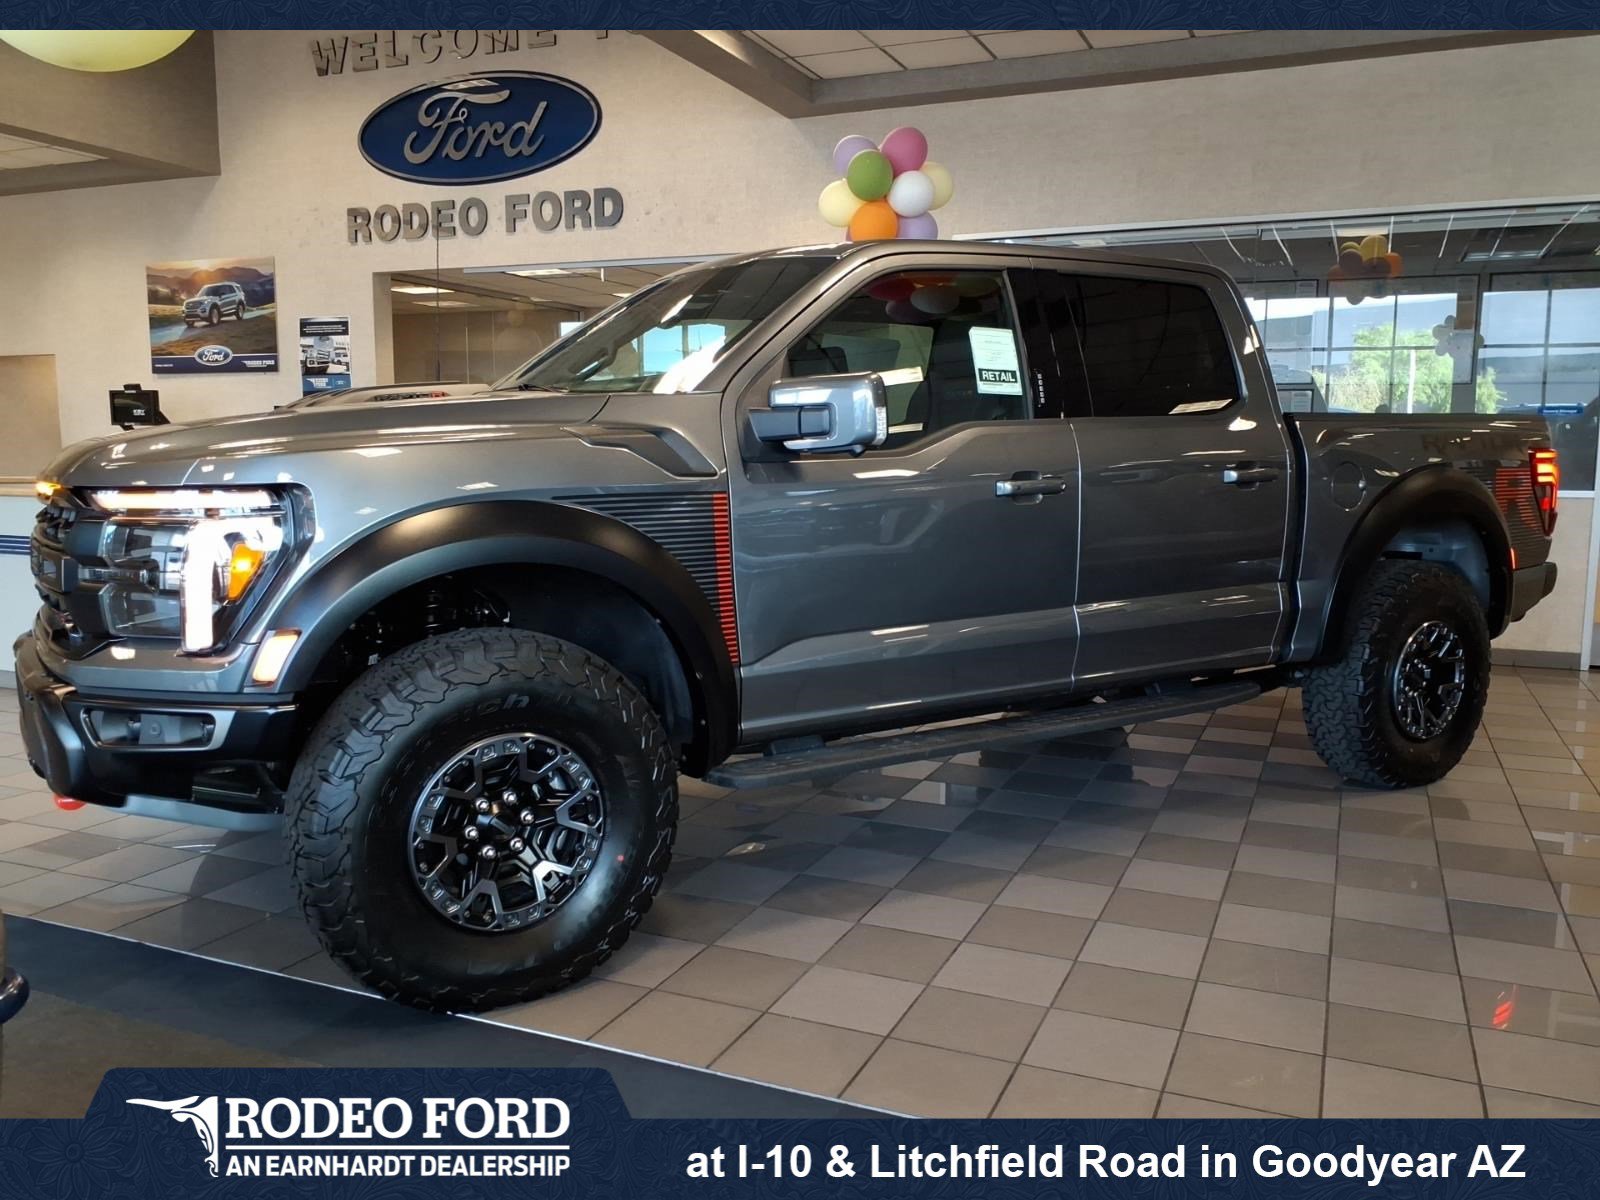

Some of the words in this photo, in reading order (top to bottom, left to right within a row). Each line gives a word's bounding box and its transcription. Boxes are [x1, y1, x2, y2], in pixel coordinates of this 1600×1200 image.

[403, 89, 547, 164] Ford
[346, 197, 488, 245] RODEO
[505, 187, 624, 234] FORD
[202, 348, 225, 361] Ford
[982, 370, 1016, 382] RETAIL
